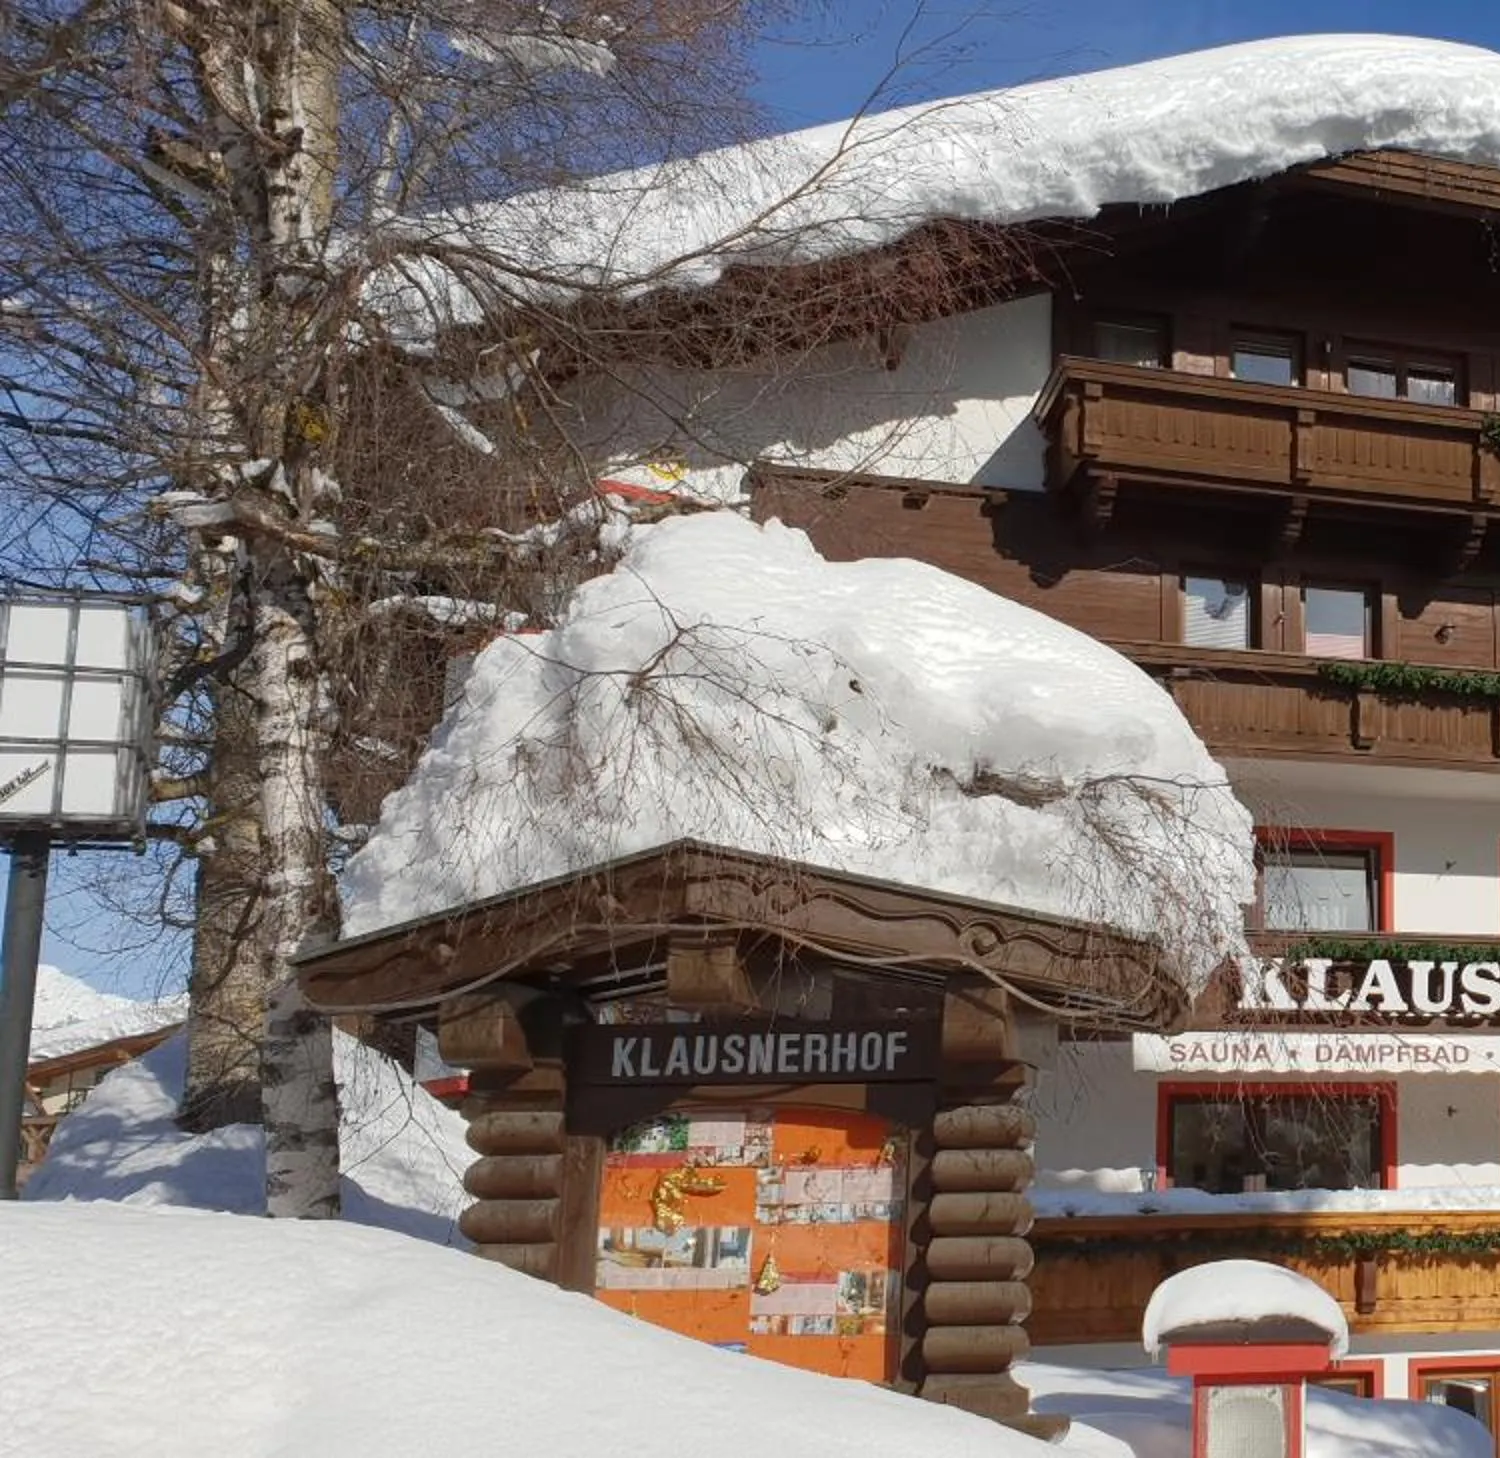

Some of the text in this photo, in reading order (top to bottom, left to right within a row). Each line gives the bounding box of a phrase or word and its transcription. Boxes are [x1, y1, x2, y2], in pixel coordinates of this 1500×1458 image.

[610, 1030, 908, 1078] KLAUSNERHOF
[1168, 1041, 1273, 1064] SAUNA
[1314, 1043, 1470, 1064] DAMPFBAD
